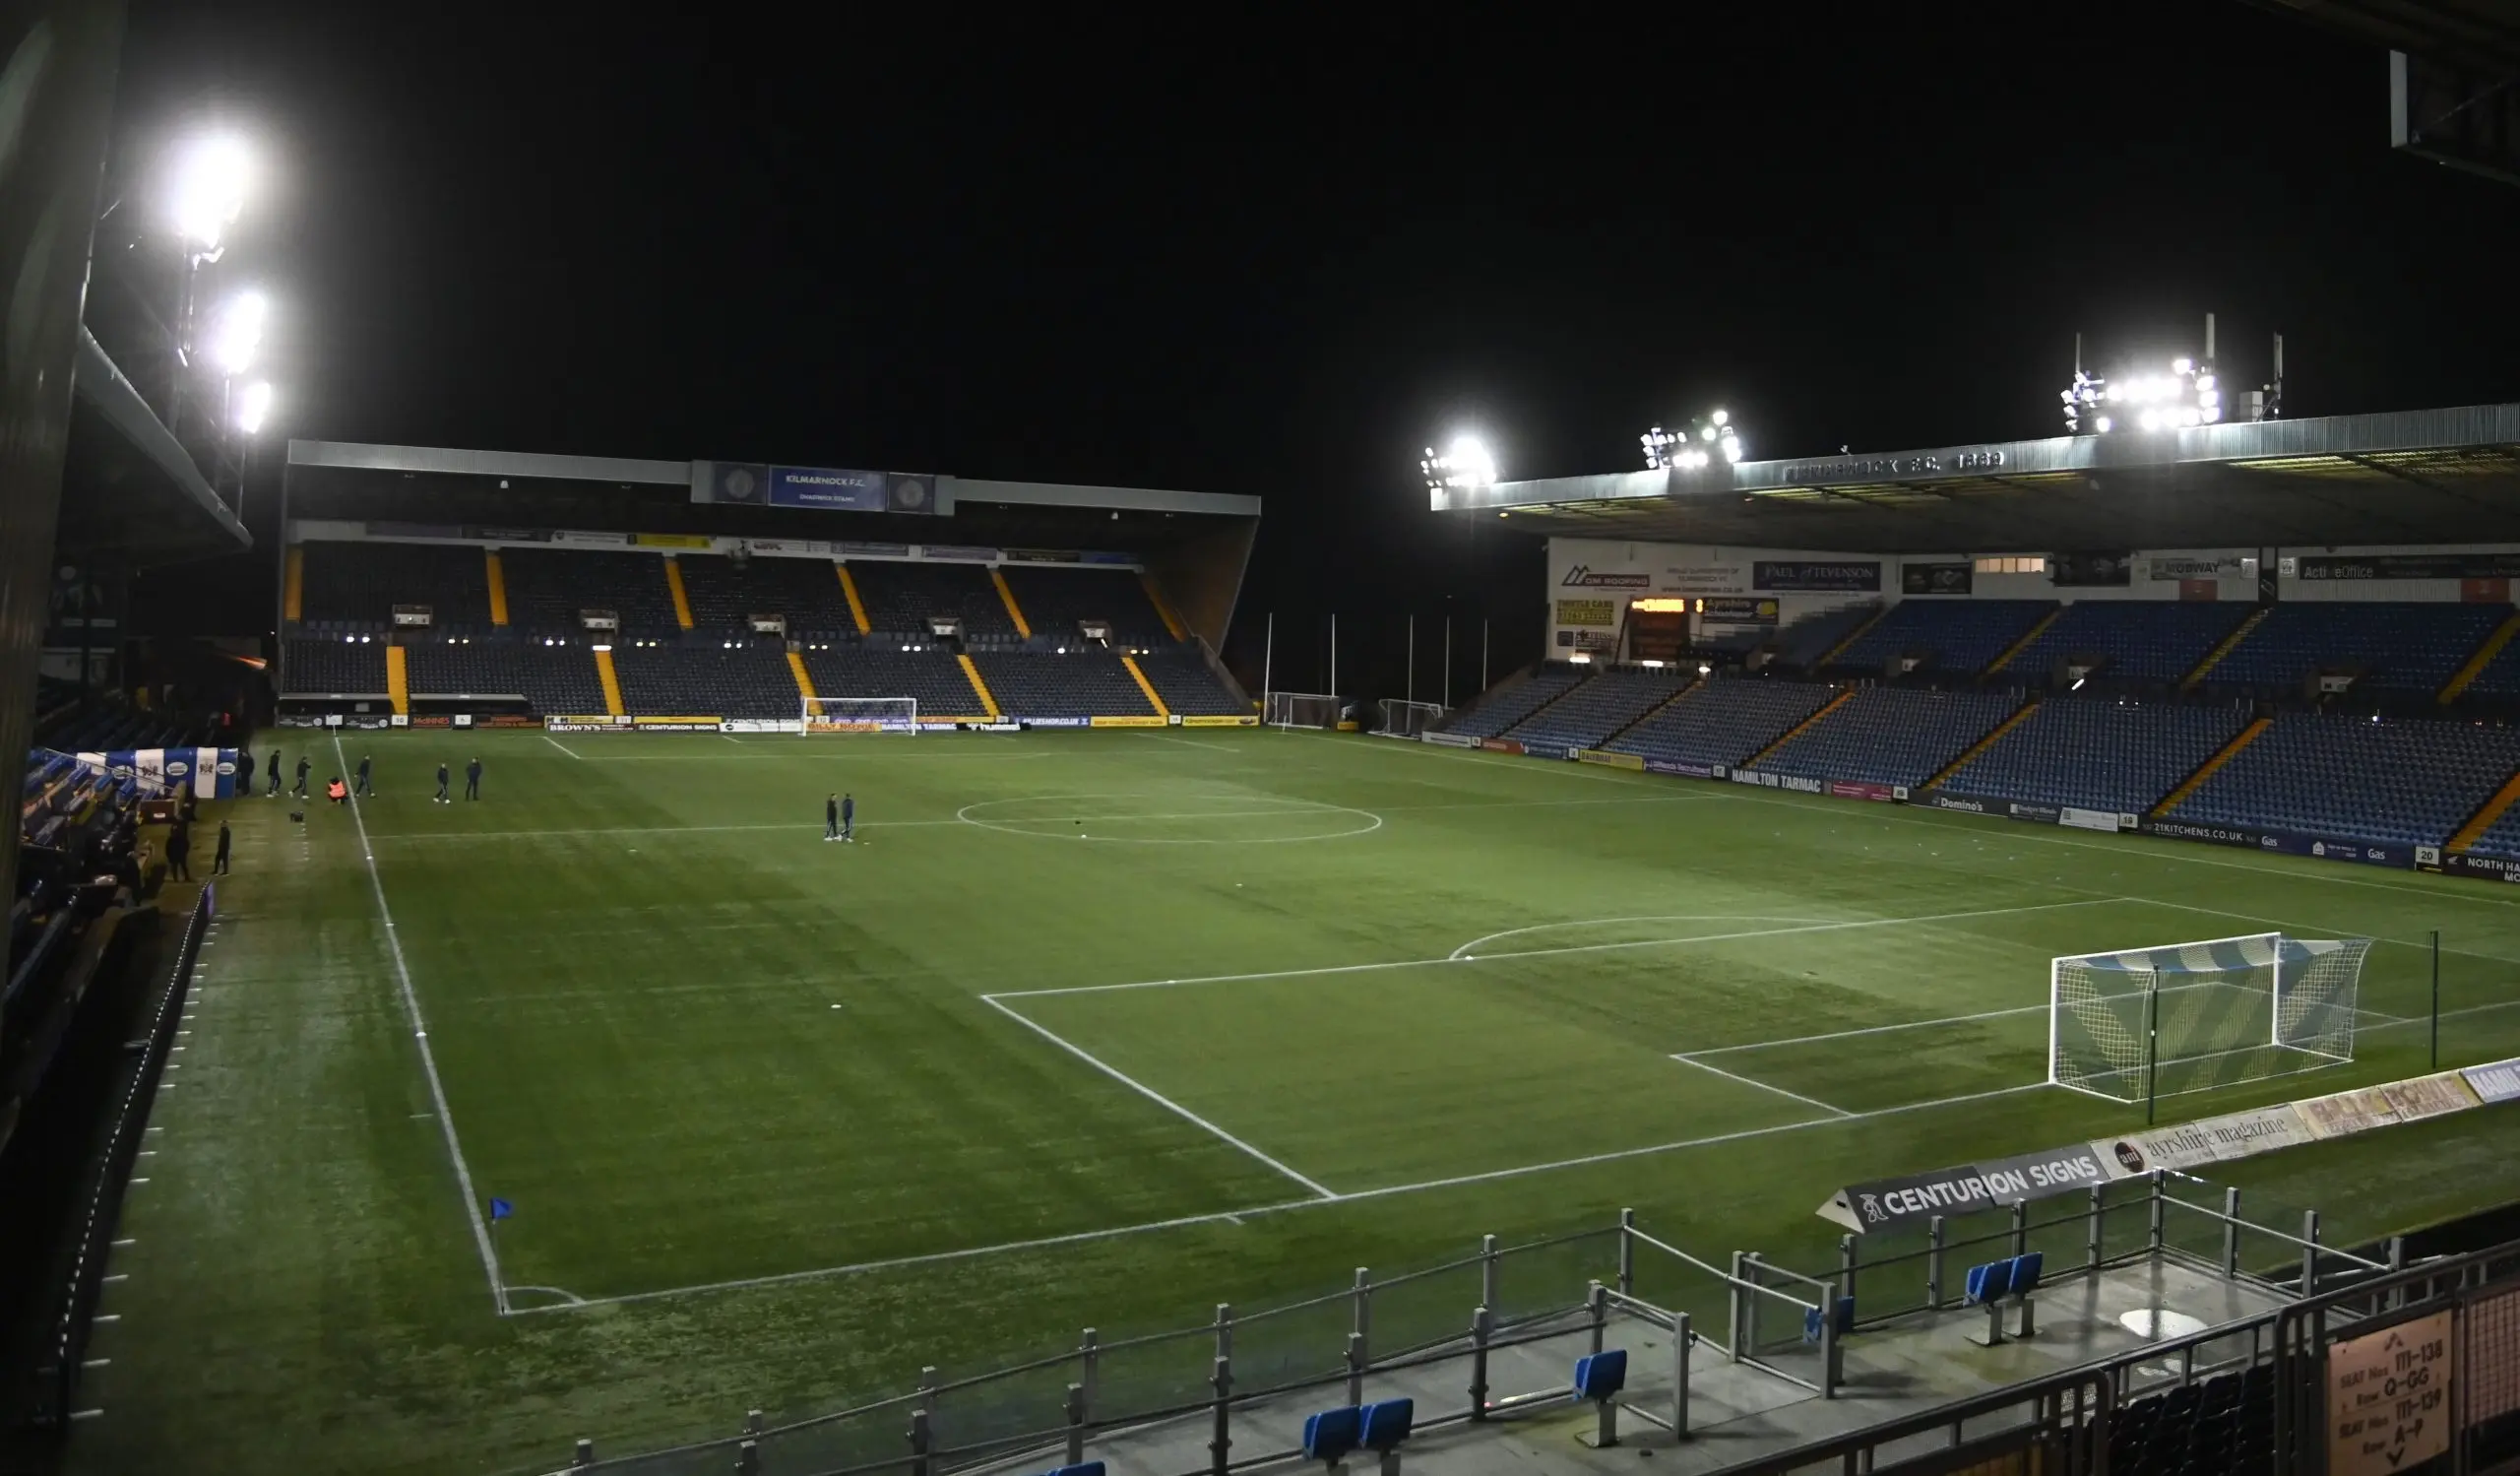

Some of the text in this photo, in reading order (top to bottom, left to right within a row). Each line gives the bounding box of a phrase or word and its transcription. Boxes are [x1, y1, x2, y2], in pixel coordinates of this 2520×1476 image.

[786, 475, 848, 486] KILMARNOCK
[1765, 565, 1874, 579] PAUL STEVENSON
[2304, 565, 2373, 578] ActieOffice
[1706, 599, 1751, 610] Ayrshire
[1732, 769, 1779, 787] HAMILTON
[1781, 775, 1821, 794] TARMAC
[1940, 798, 1984, 812] Domino's
[2154, 823, 2243, 842] 21KITCHENS.CO.UK
[2261, 835, 2278, 847] Gas
[2367, 848, 2386, 860] Gas
[2422, 851, 2433, 861] 20
[2467, 858, 2503, 870] NORTH
[2146, 1128, 2214, 1157] ayrshire
[2215, 1116, 2288, 1144] magazine
[1884, 1155, 2099, 1215] CENTURION SIGNS
[2340, 1370, 2364, 1388] SEAT
